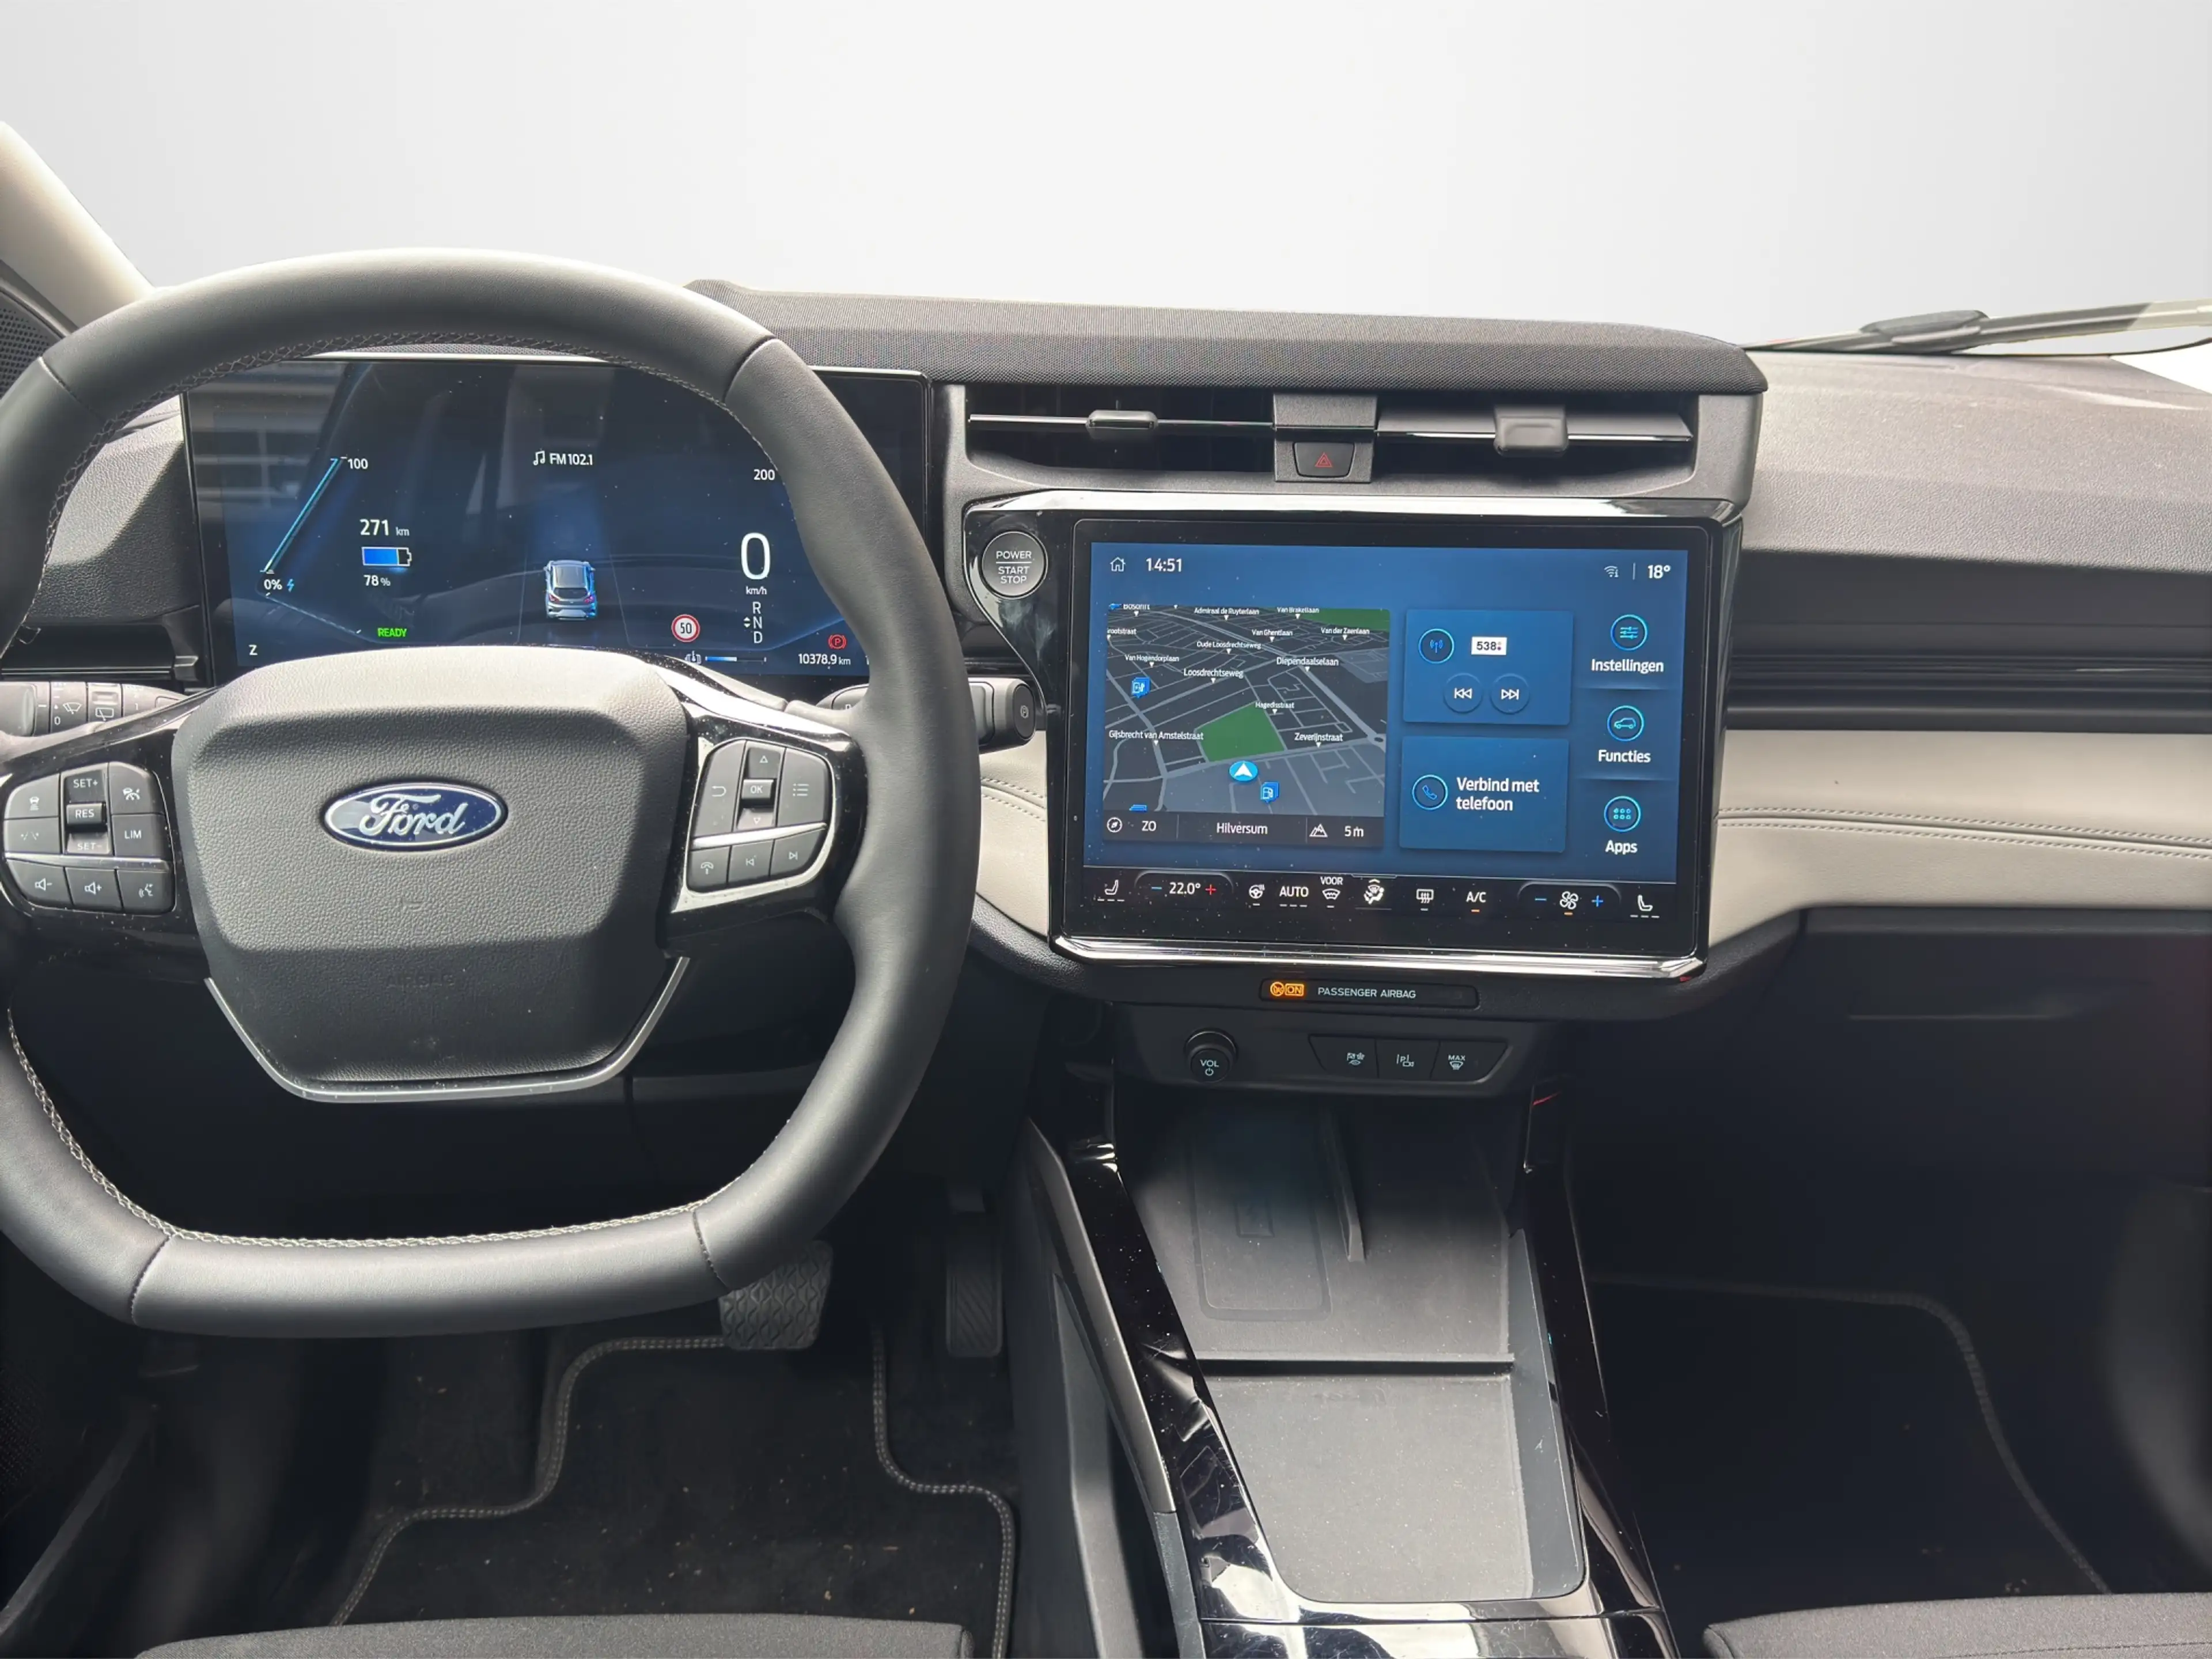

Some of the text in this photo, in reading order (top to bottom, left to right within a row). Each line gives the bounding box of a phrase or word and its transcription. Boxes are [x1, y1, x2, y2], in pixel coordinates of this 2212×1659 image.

[347, 458, 368, 470] 100
[753, 469, 775, 481] 200
[359, 519, 410, 536] 271 km
[740, 532, 771, 579] 0
[995, 550, 1032, 559] POWER
[998, 566, 1030, 574] START
[1145, 558, 1183, 573] 14:51
[1647, 564, 1671, 579] 18°
[263, 578, 283, 590] 0%
[1000, 575, 1027, 584] STOP
[745, 586, 767, 596] km/h
[752, 601, 762, 614] R
[680, 622, 692, 634] 50
[753, 616, 763, 629] N
[377, 627, 407, 638] READY
[753, 631, 763, 643] D
[248, 644, 258, 656] Z
[798, 653, 851, 665] 10378.9 km
[1137, 654, 1180, 663] Hogendorplaan
[1277, 657, 1339, 666] Diependaalselaan
[1591, 658, 1664, 674] Instellingen
[1184, 668, 1244, 679] Loosdrechtseweg
[1109, 730, 1143, 740] Gijsbrecht
[1158, 731, 1204, 741] Amstelstraat
[1294, 732, 1343, 743] Zeverijnstraat
[1598, 749, 1651, 764] Functies
[73, 779, 99, 789] SET+
[750, 786, 763, 794] OK
[1456, 777, 1540, 793] Verbind met
[1456, 797, 1513, 811] telefoon
[75, 809, 94, 818] RES
[359, 793, 468, 836] Ford
[1141, 820, 1157, 832] ZO
[1216, 822, 1268, 835] Hilversum
[1344, 826, 1364, 838] 5 m
[124, 830, 142, 839] LIM
[1605, 840, 1638, 855] Apps
[1320, 876, 1343, 886] VOOR
[1169, 882, 1201, 895] 22.0°
[1279, 887, 1309, 898] AUTO
[1466, 891, 1487, 903] A/C
[1286, 986, 1302, 994] ON
[1317, 987, 1416, 998] PASSENGER AIRBAG
[1199, 1059, 1219, 1067] VOL
